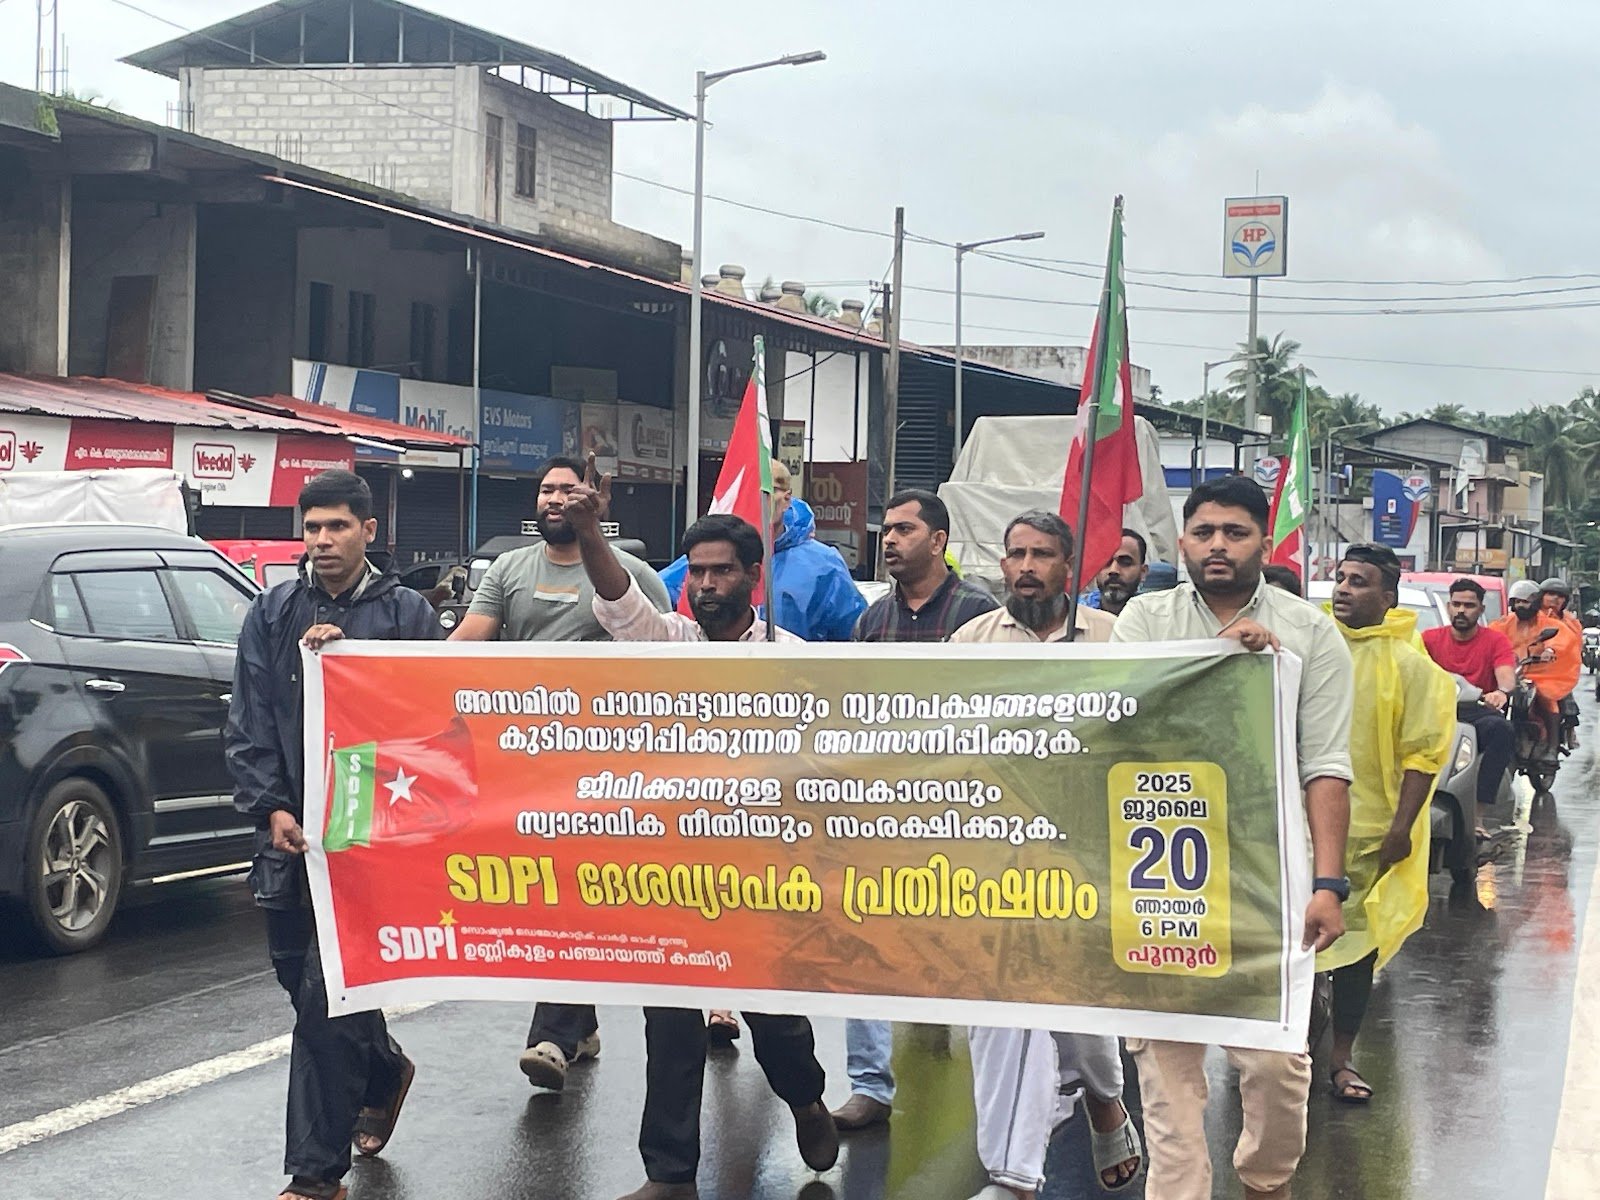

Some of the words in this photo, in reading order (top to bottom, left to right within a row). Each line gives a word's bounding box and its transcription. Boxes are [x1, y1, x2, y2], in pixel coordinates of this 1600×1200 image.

[1243, 229, 1267, 242] HP
[483, 406, 501, 426] EVS
[503, 408, 532, 429] Motors
[196, 451, 232, 472] Veedol
[454, 685, 580, 716] അസമിൽ
[592, 691, 829, 723] പാവപ്പെട്ടവരേയും
[843, 691, 1138, 724] ന്യൂനപക്ഷങ്ങളേയും
[498, 721, 807, 759] കുടിയൊഴിപ്പിക്കുന്നത്
[814, 724, 1090, 760] അവസാനിപ്പിക്കുക.
[577, 770, 782, 807] ജീവിക്കാനുള്ള
[795, 777, 1002, 808] അവകാശവും
[1137, 774, 1192, 792] 2025
[1123, 799, 1207, 821] ജൂലൈ
[516, 806, 666, 839] സ്വാഭാവിക
[678, 808, 813, 843] നീതിയും
[825, 809, 1067, 846] സംരക്ഷിക്കുക.
[1129, 827, 1209, 891] 20
[446, 853, 559, 905] SDPI
[576, 862, 822, 920] ദേശവ്യാപക
[842, 852, 1099, 923] പ്രതിഷേധം
[1134, 898, 1206, 915] ഞായർ
[1142, 920, 1152, 936] 6
[1161, 920, 1198, 937] PM
[378, 925, 457, 962] SDPI
[463, 939, 554, 963] ഉണ്ണികുളം
[559, 945, 665, 964] പഞ്ചായത്ത്
[670, 950, 732, 972] കമ്മിറ്റി
[1128, 944, 1217, 969] പൂനൂർ
